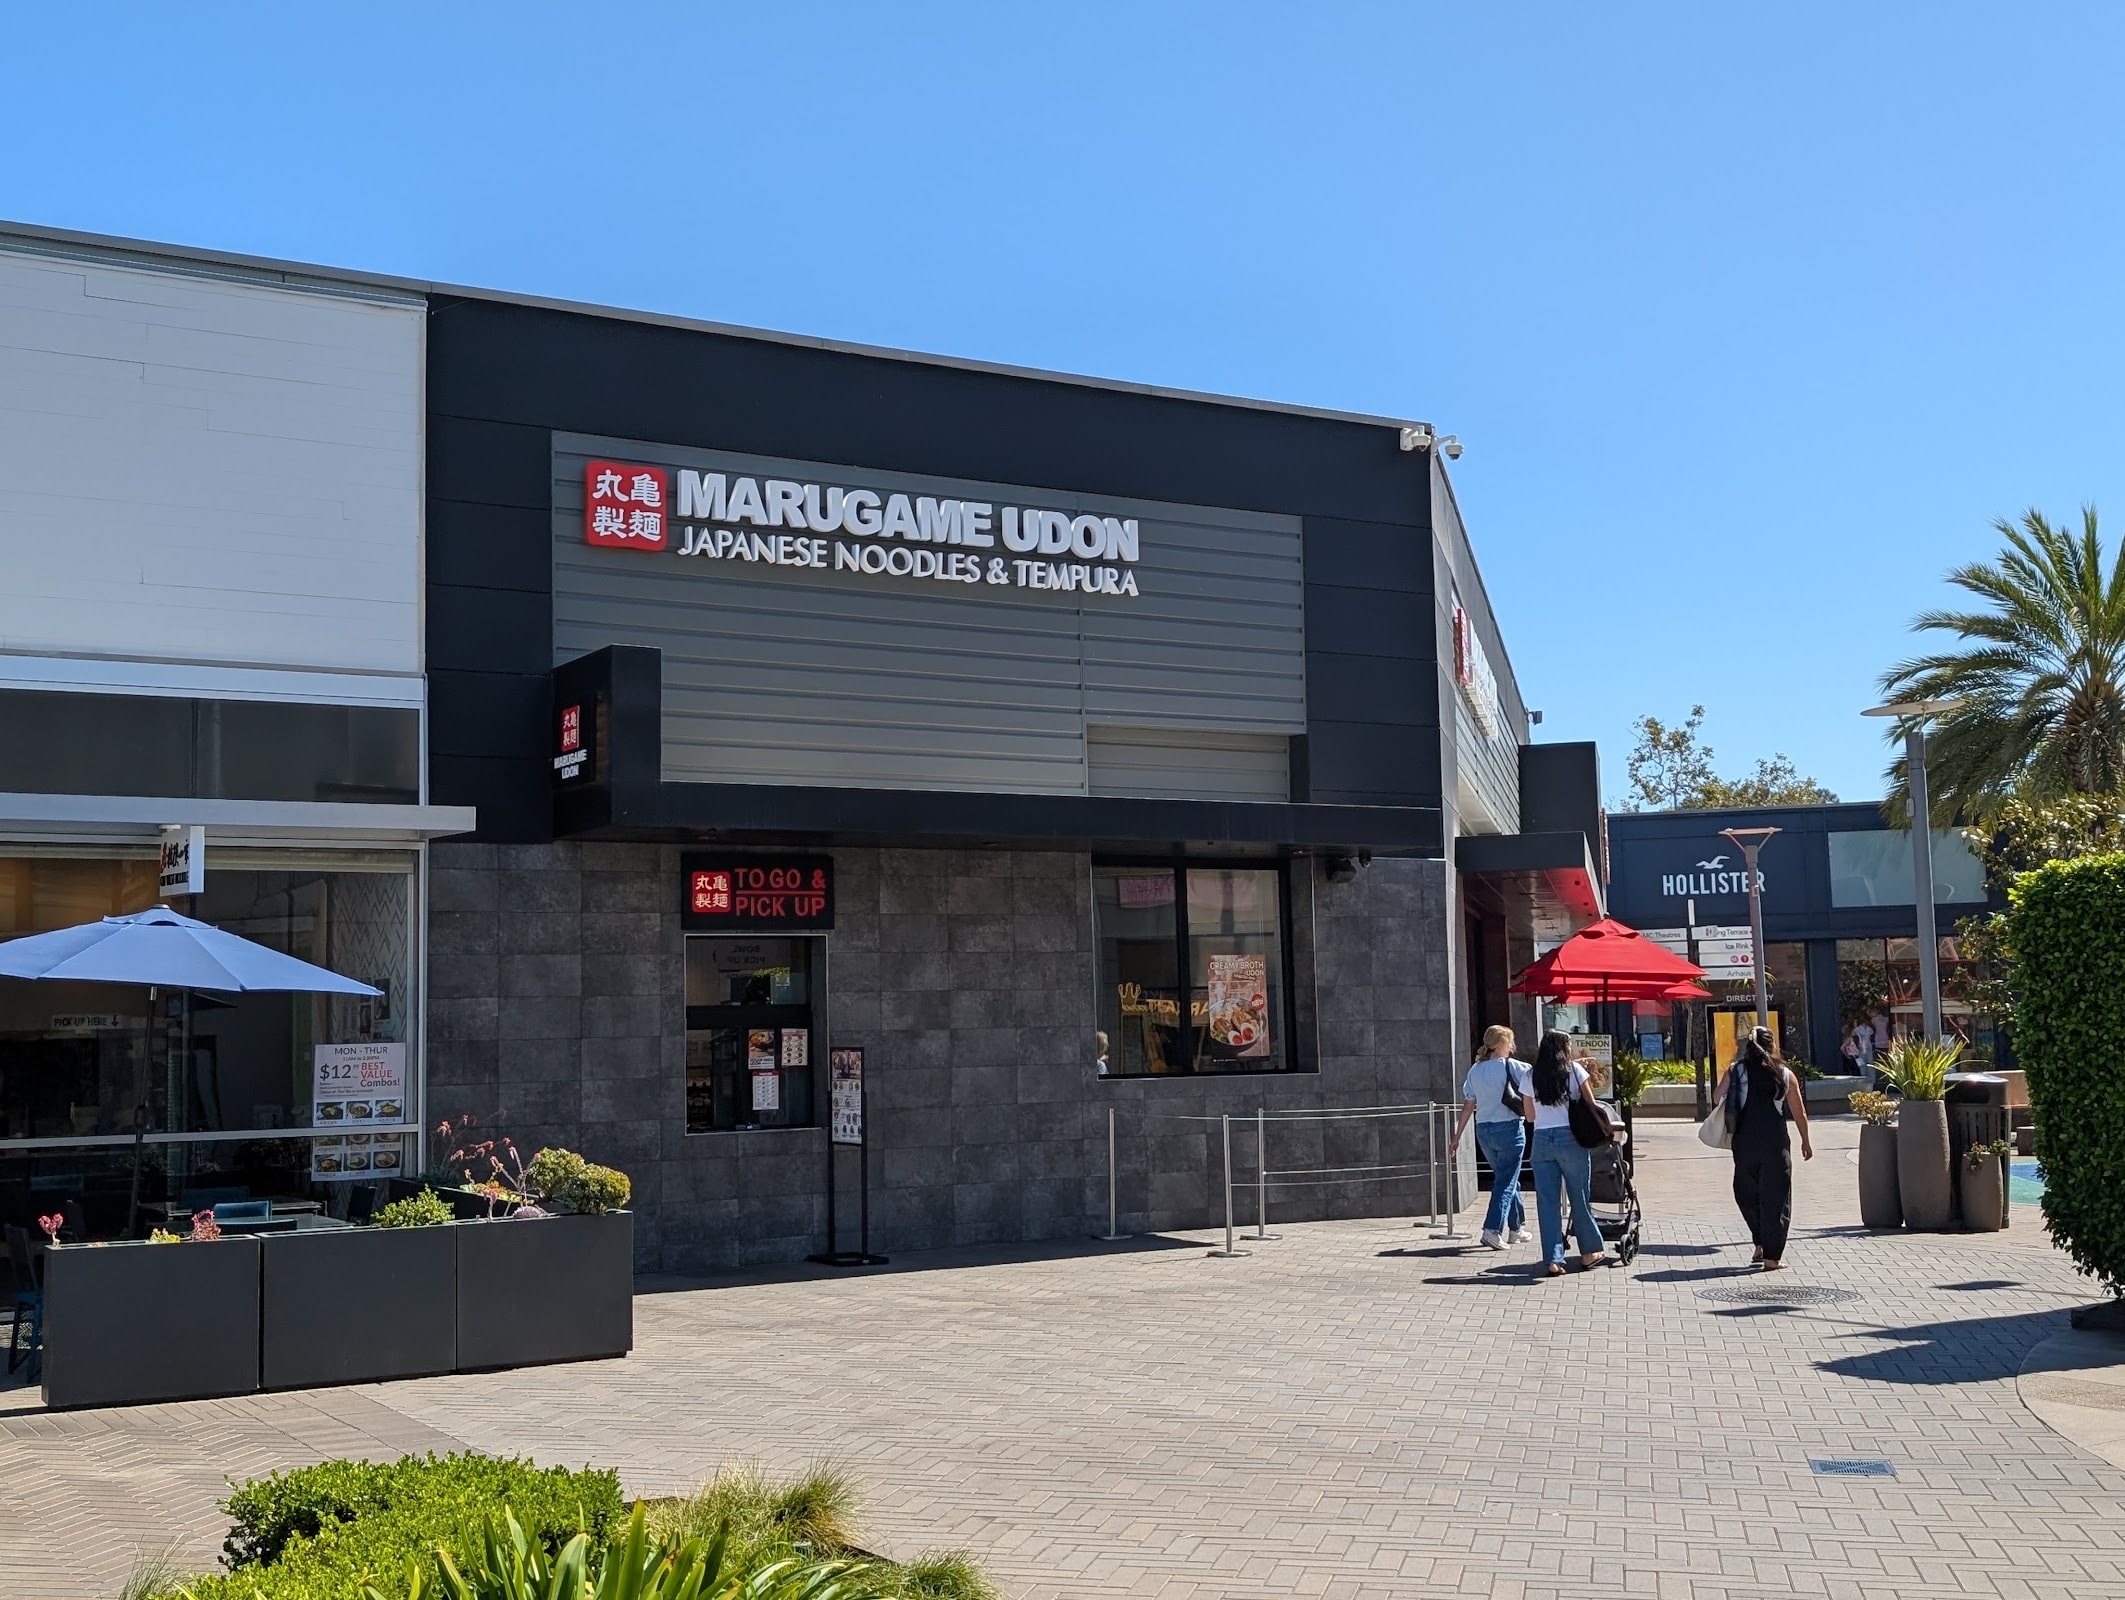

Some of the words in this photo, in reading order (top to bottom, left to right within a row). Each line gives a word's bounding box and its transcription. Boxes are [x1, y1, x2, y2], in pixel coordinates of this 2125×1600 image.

[592, 469, 661, 507] 丸亀
[677, 469, 995, 548] MARUGAME
[1001, 506, 1140, 562] UDON
[677, 526, 828, 569] JAPANESE
[835, 541, 981, 584] NOODLES
[986, 557, 1009, 585] &
[1013, 559, 1140, 596] TEMPURA
[554, 749, 587, 769] MARUGAME
[561, 764, 579, 779] UDON
[695, 874, 728, 891] 丸亀
[734, 868, 765, 888] TO
[769, 868, 801, 889] GO
[812, 868, 826, 889] &
[1662, 871, 1766, 896] HOLLISTER
[735, 897, 786, 917] PICK
[794, 897, 826, 917] UP
[1655, 931, 1681, 939] Theatres
[1209, 961, 1239, 970] CREAMY
[1240, 961, 1264, 969] BROTH
[54, 1017, 72, 1027] PICK
[74, 1017, 86, 1027] UP
[87, 1017, 107, 1026] HERE
[334, 1047, 357, 1055] MON
[364, 1046, 388, 1054] THUR
[319, 1063, 352, 1081] $12
[360, 1070, 393, 1078] VALUE
[361, 1062, 385, 1071] BEST
[360, 1078, 401, 1087] Combos!
